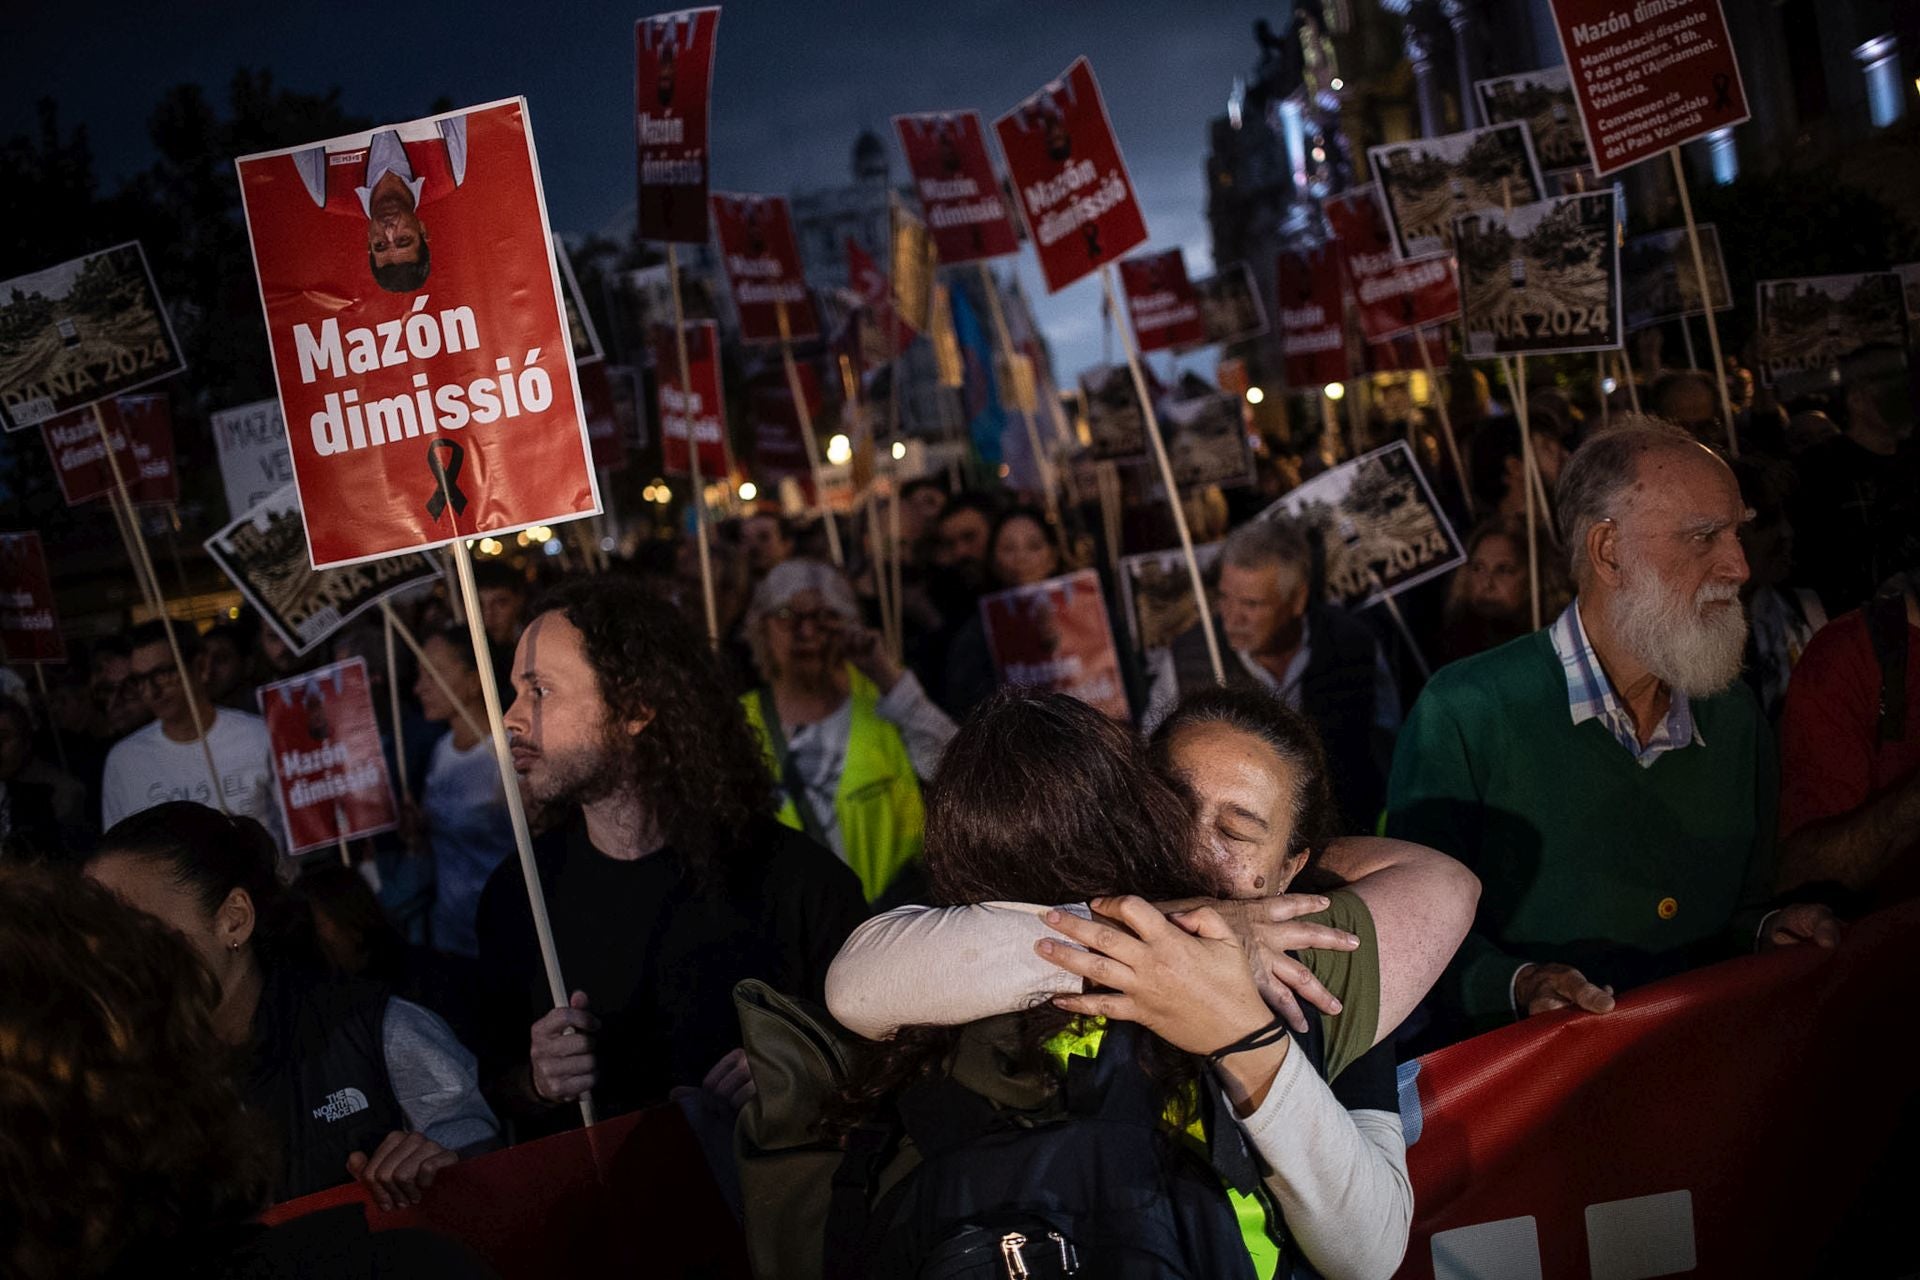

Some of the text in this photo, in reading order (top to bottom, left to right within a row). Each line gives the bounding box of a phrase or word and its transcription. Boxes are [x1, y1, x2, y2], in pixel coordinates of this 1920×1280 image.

[1571, 10, 1631, 47] Mazón
[1580, 29, 1656, 69] Manifestació
[1583, 70, 1593, 82] 9
[1595, 65, 1612, 79] de
[1587, 77, 1624, 96] Plaça
[1624, 69, 1641, 82] de
[1597, 99, 1665, 131] Convoquen
[1602, 113, 1669, 146] moviments
[1606, 142, 1626, 159] del
[1533, 301, 1610, 338] 2024
[292, 294, 480, 384] Mazón
[104, 337, 170, 382] 2024
[309, 347, 553, 457] dimissió
[312, 1098, 350, 1119] NORTH
[325, 1089, 346, 1103] THE
[326, 1107, 351, 1123] FACE
